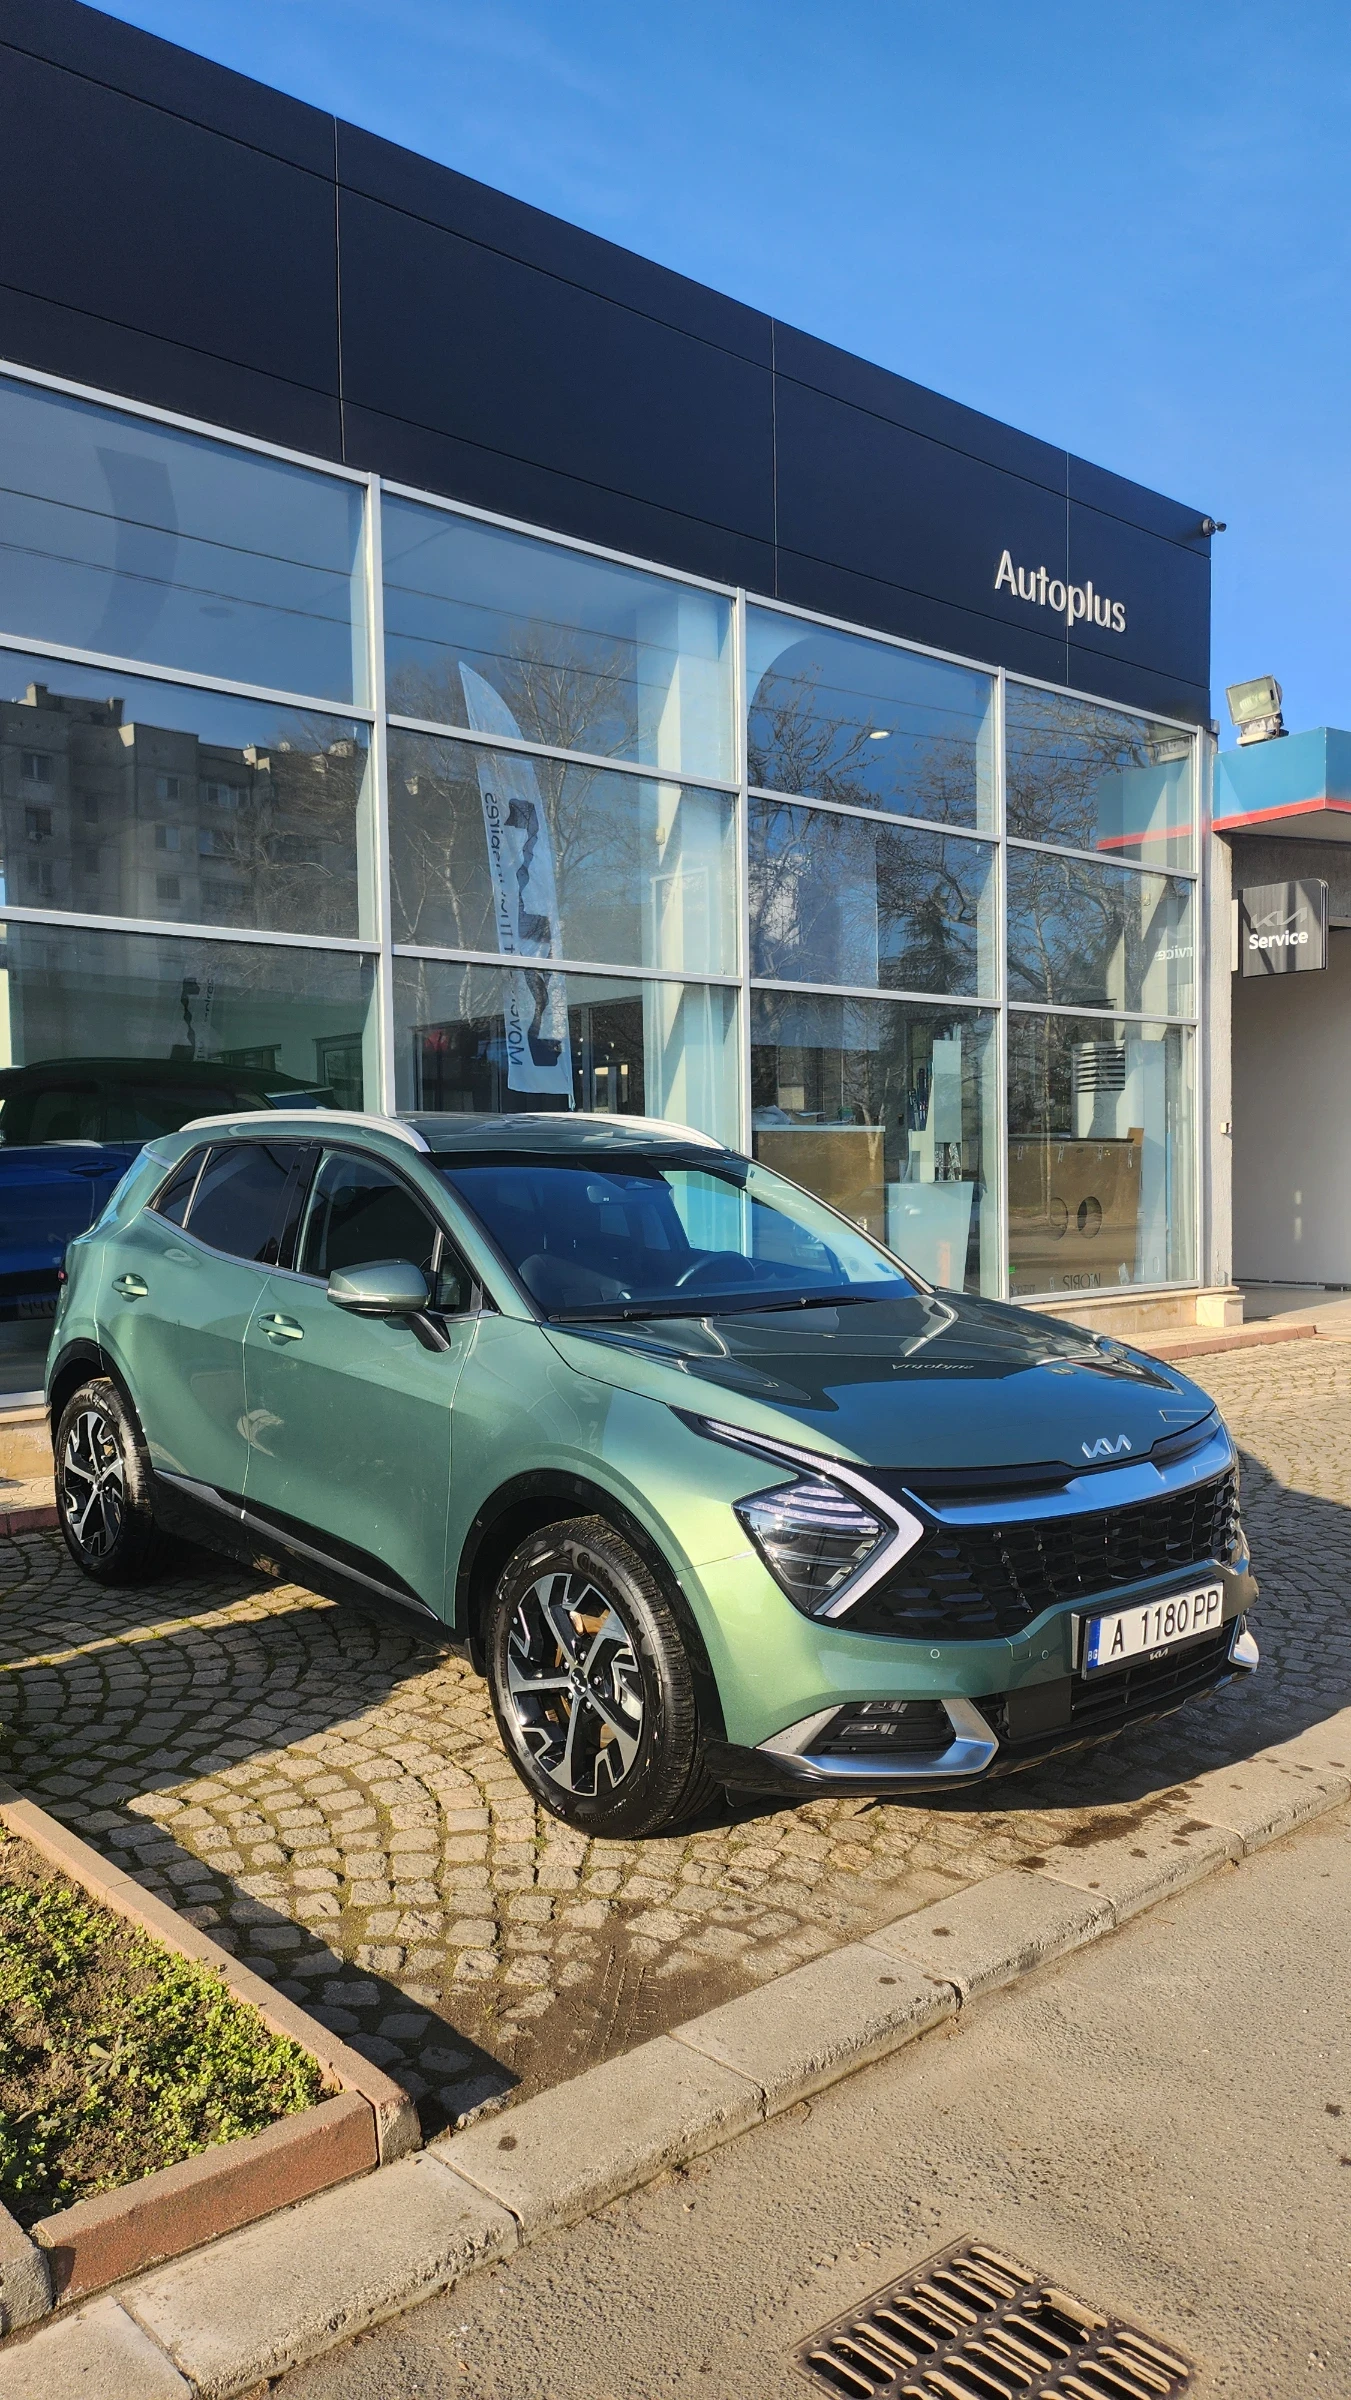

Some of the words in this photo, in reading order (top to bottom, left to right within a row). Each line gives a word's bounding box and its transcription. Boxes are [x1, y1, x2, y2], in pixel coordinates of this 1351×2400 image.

[995, 550, 1127, 634] Autoplus
[1249, 930, 1309, 950] Service
[1087, 1650, 1098, 1661] BG
[1110, 1618, 1124, 1656] A
[1140, 1599, 1188, 1646] 1180
[1192, 1590, 1219, 1629] PP
